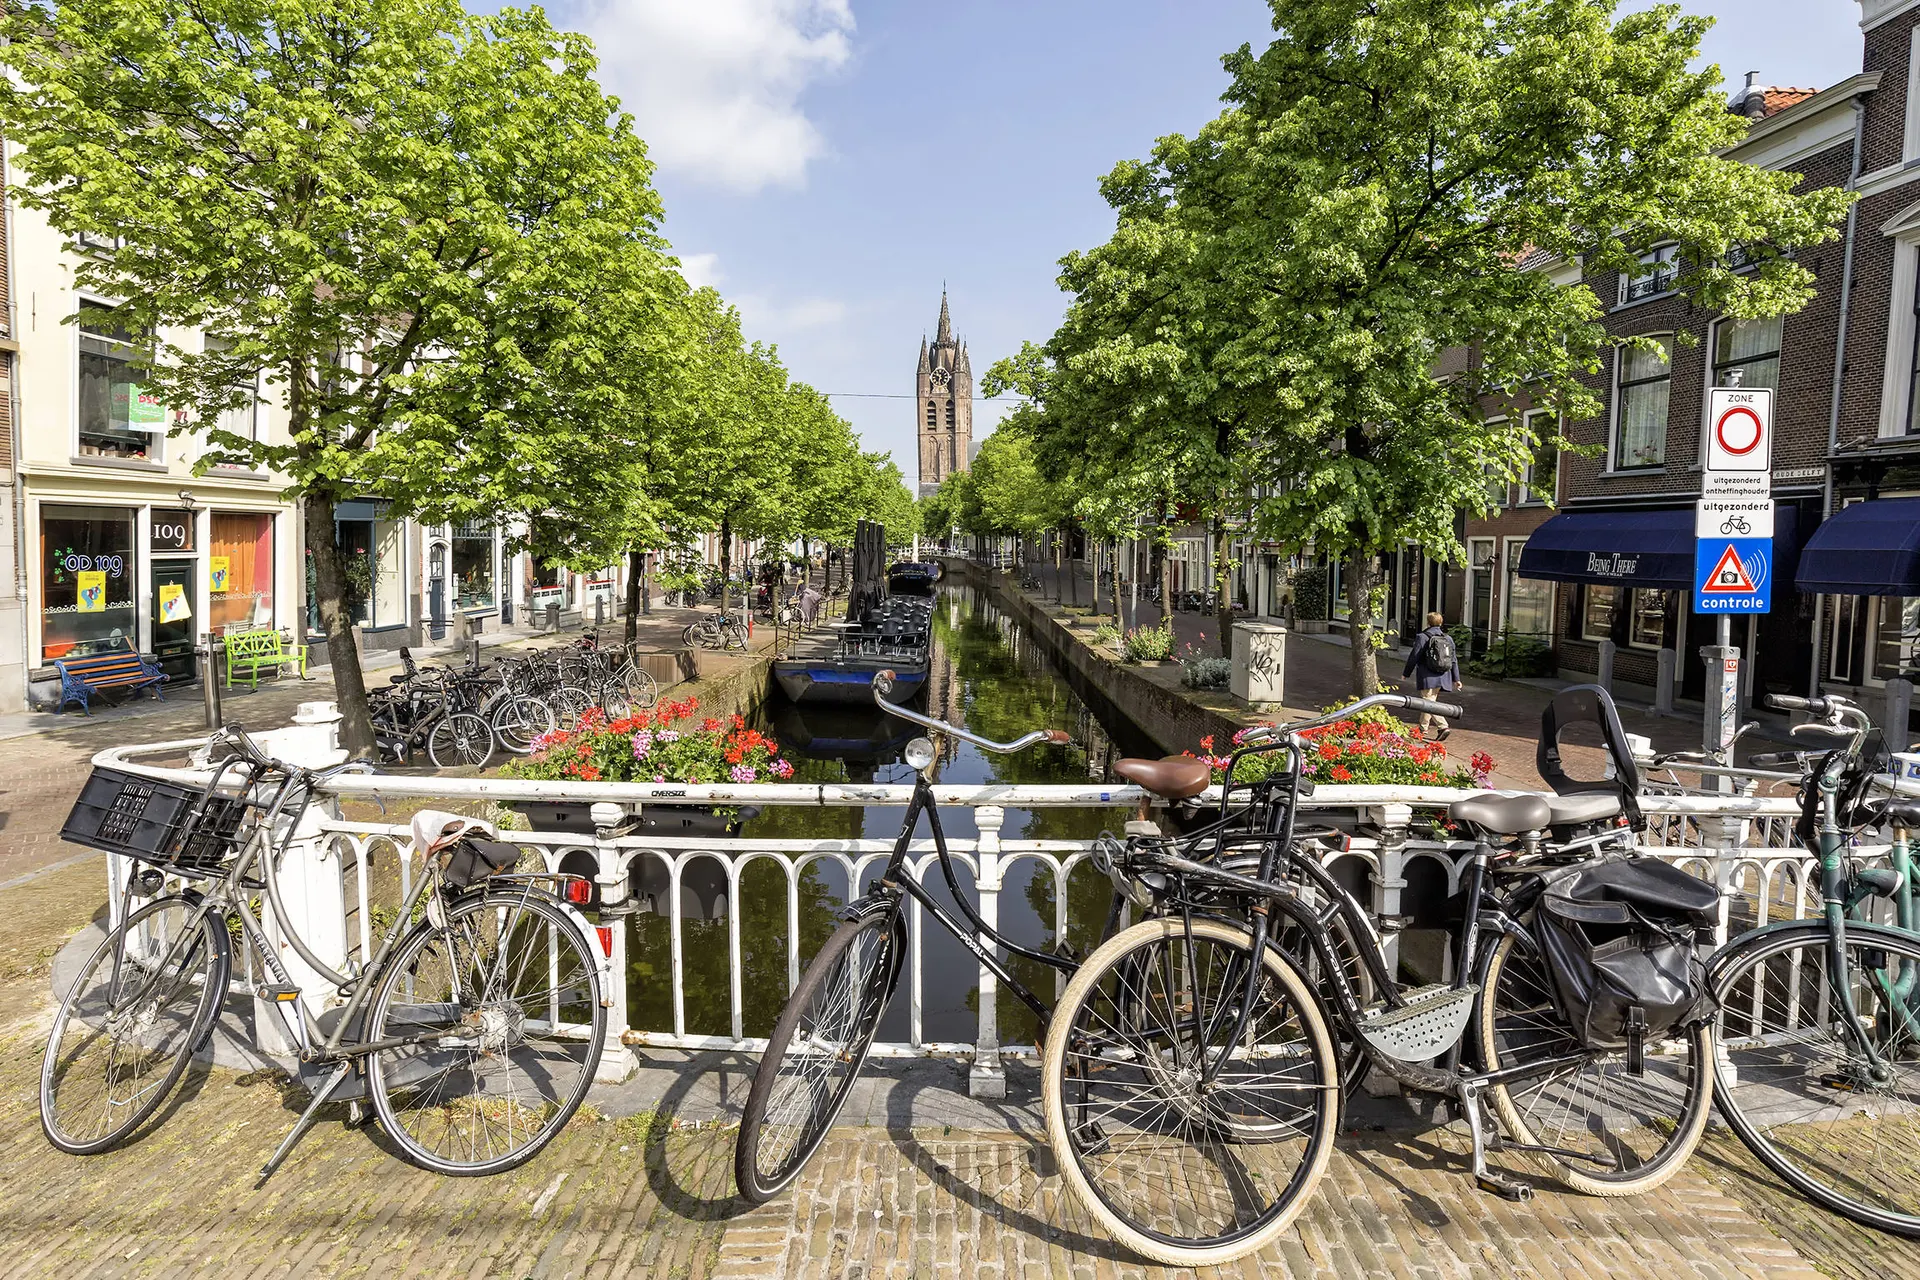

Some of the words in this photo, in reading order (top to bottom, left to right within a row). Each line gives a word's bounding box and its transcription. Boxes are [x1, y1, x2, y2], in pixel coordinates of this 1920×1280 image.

[1728, 394, 1754, 403] ZONE
[1713, 477, 1761, 485] uitgezonderd
[1705, 488, 1768, 496] ontheffinghouder
[1703, 503, 1769, 513] uitgezonderd
[154, 524, 186, 548] 109
[65, 554, 93, 572] OD
[95, 554, 123, 578] 109
[1586, 551, 1611, 572] BEING
[1611, 552, 1637, 574] THERE
[1701, 596, 1764, 609] controle
[960, 932, 985, 958] POPAL
